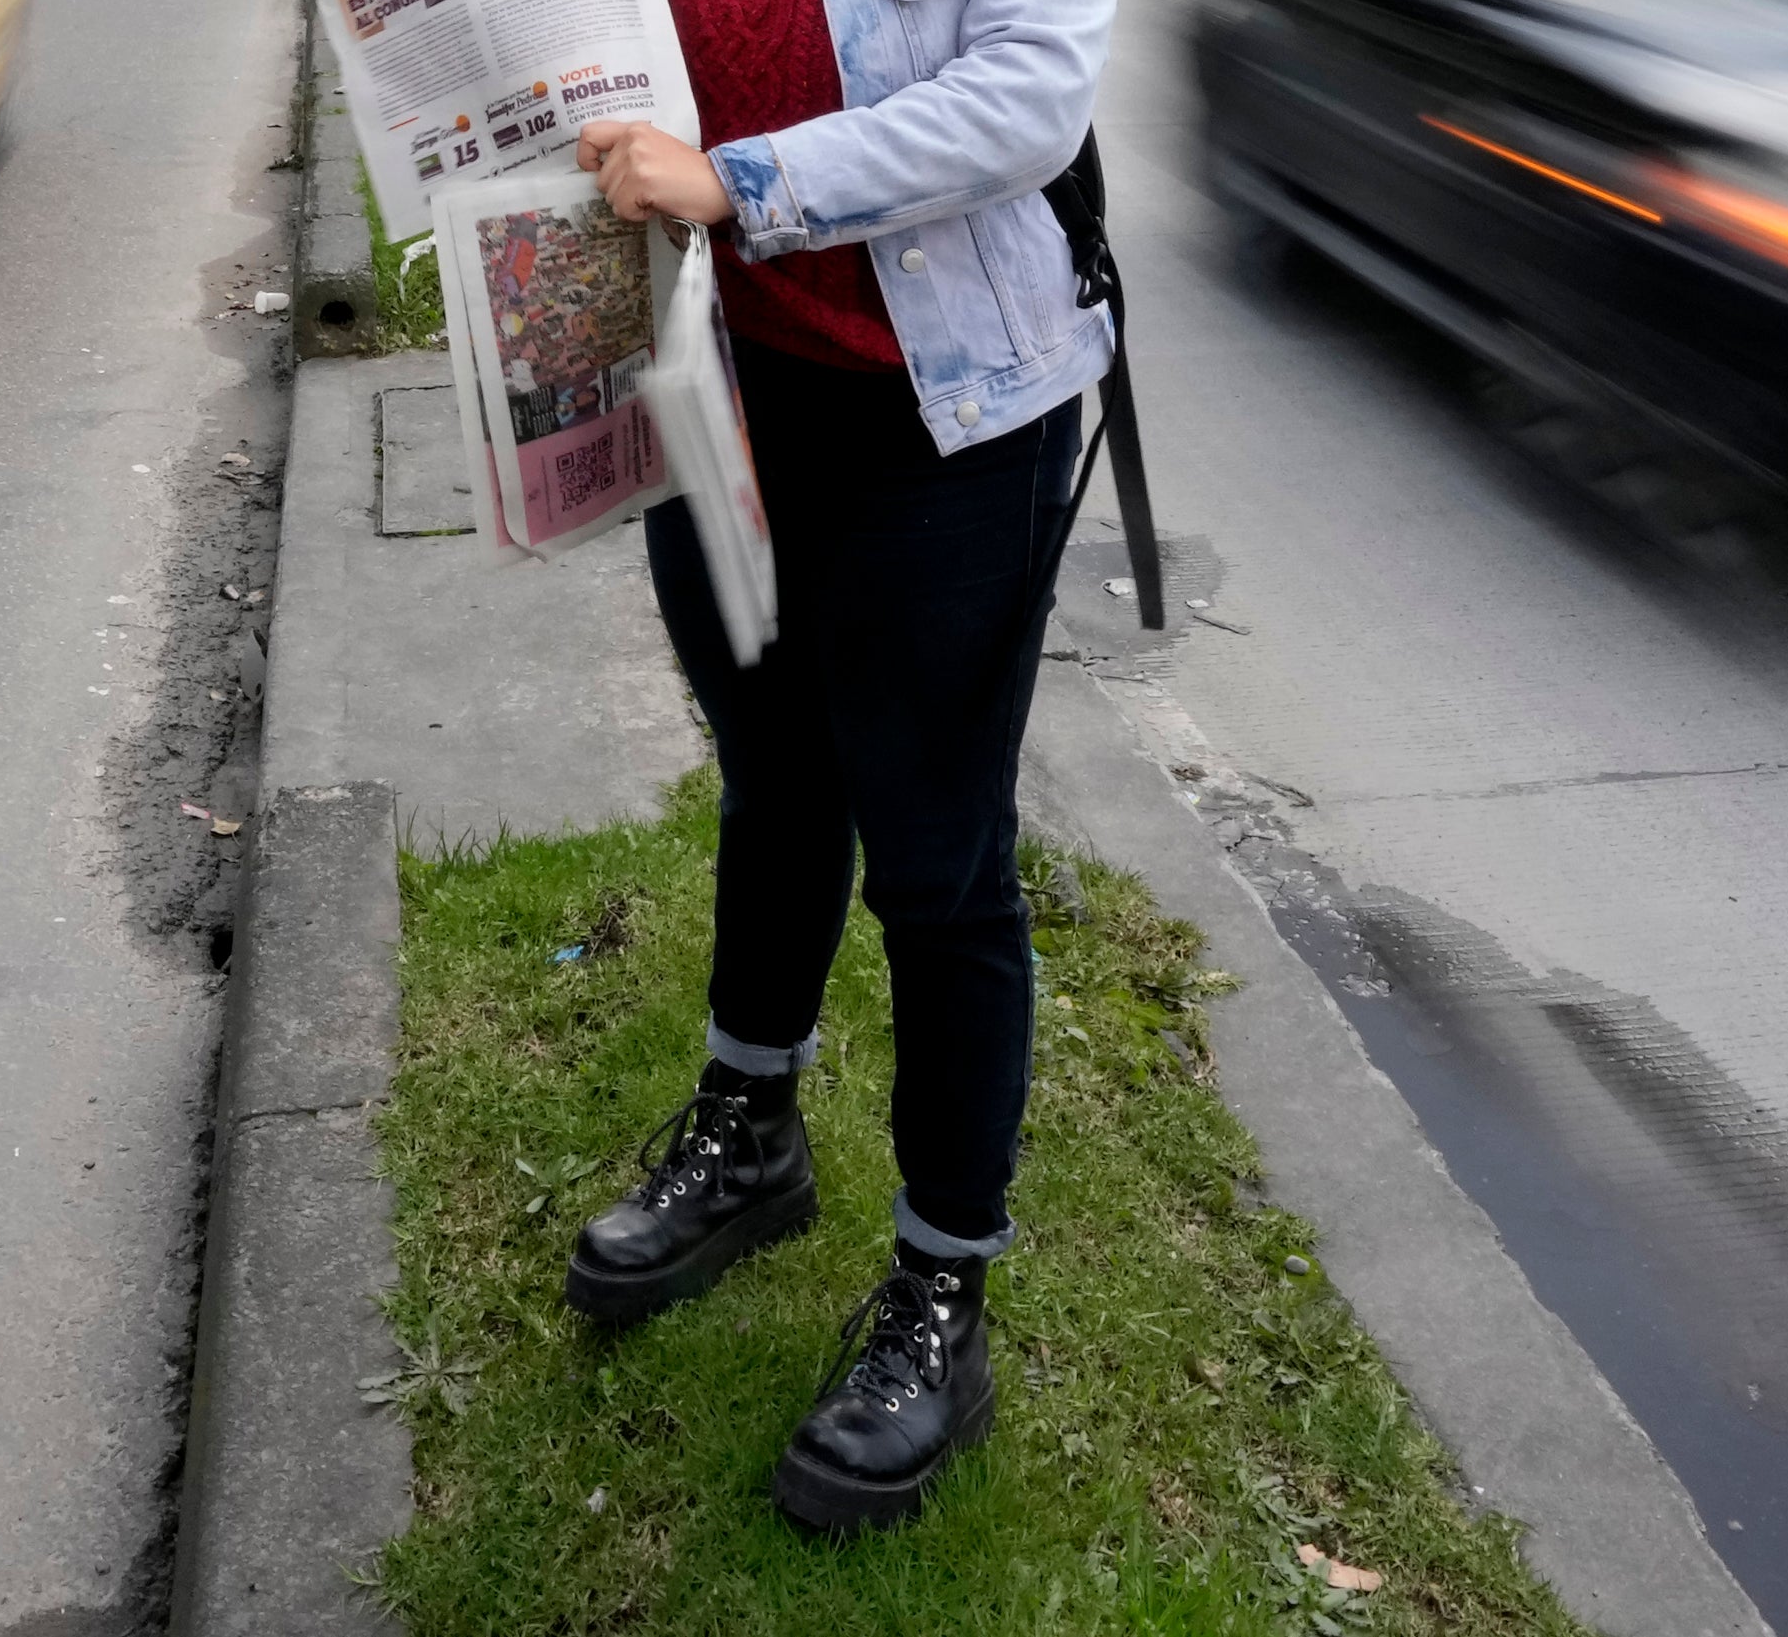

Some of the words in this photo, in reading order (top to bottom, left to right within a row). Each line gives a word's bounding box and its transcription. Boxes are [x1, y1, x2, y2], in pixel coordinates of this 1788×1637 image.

[559, 64, 603, 84] VOTE
[561, 72, 650, 105] ROBLEDO
[525, 110, 557, 138] 102
[569, 110, 604, 124] CENTRO
[606, 100, 655, 114] ESPERANZA
[453, 138, 481, 168] 15
